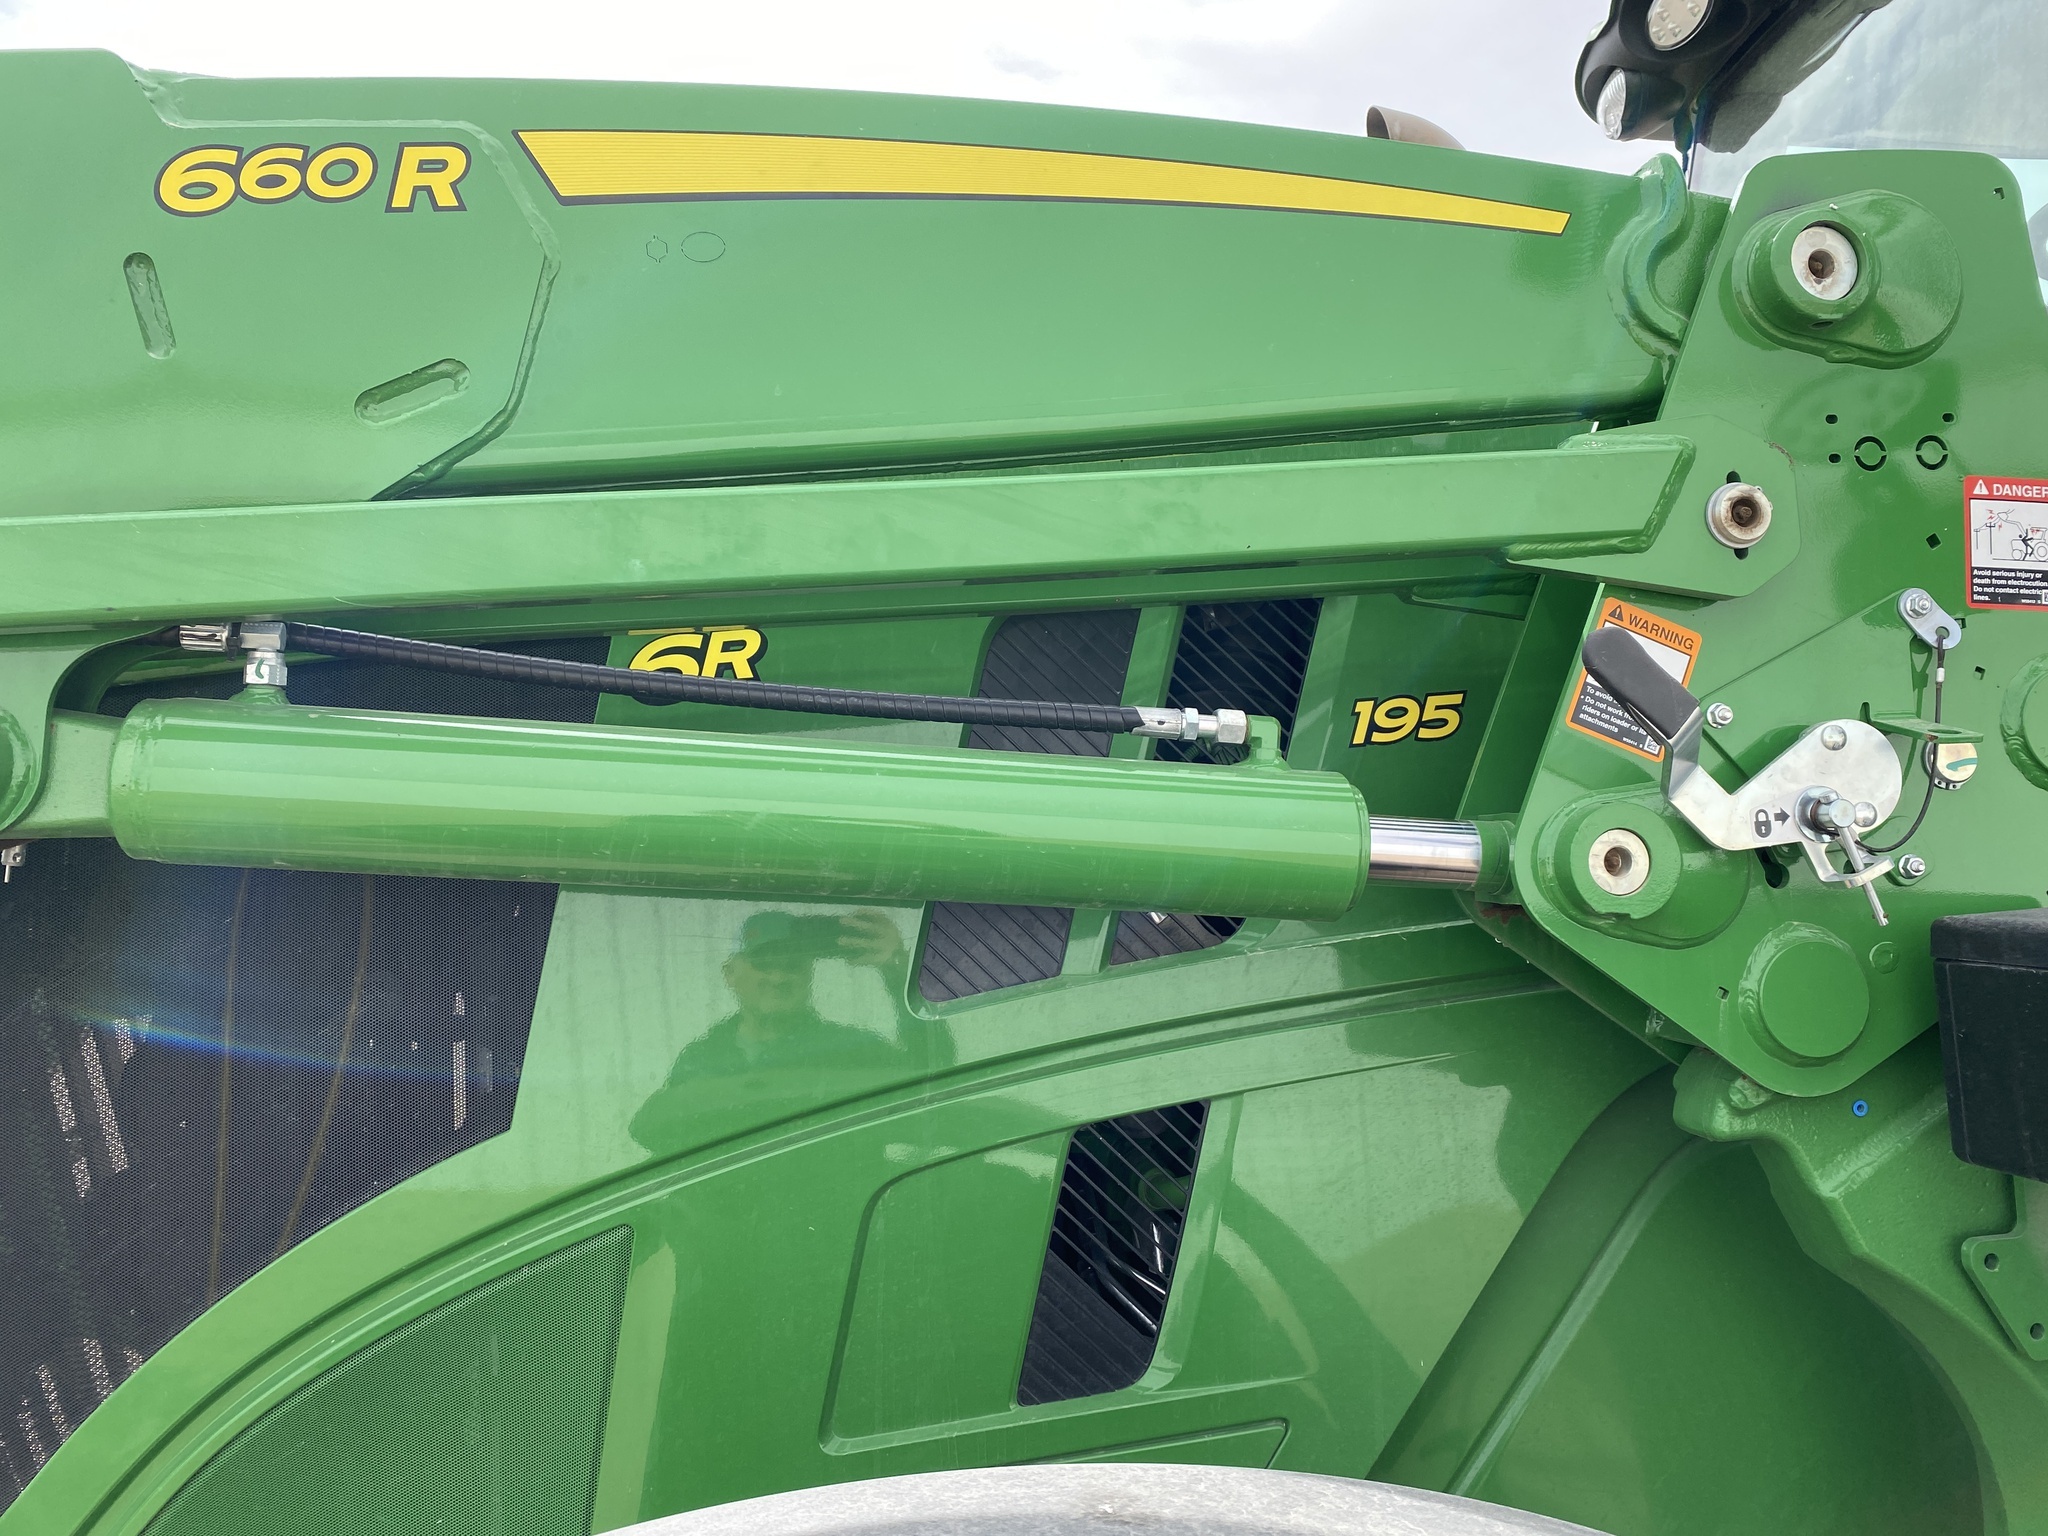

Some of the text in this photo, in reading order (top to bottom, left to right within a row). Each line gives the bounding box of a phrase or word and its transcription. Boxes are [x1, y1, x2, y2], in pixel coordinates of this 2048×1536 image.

[155, 142, 471, 216] 660 R
[1993, 484, 2048, 498] DANGER
[2016, 570, 2035, 579] injury
[1628, 613, 1694, 651] WARNING
[628, 628, 766, 681] 6R
[1586, 685, 1595, 694] To
[1585, 695, 1595, 704] Do
[1595, 700, 1606, 709] not
[1607, 705, 1624, 716] work
[1349, 690, 1467, 748] 195
[1579, 712, 1619, 733] attachments
[1581, 704, 1601, 716] riders
[1610, 715, 1631, 729] loader
[1631, 724, 1639, 732] or
